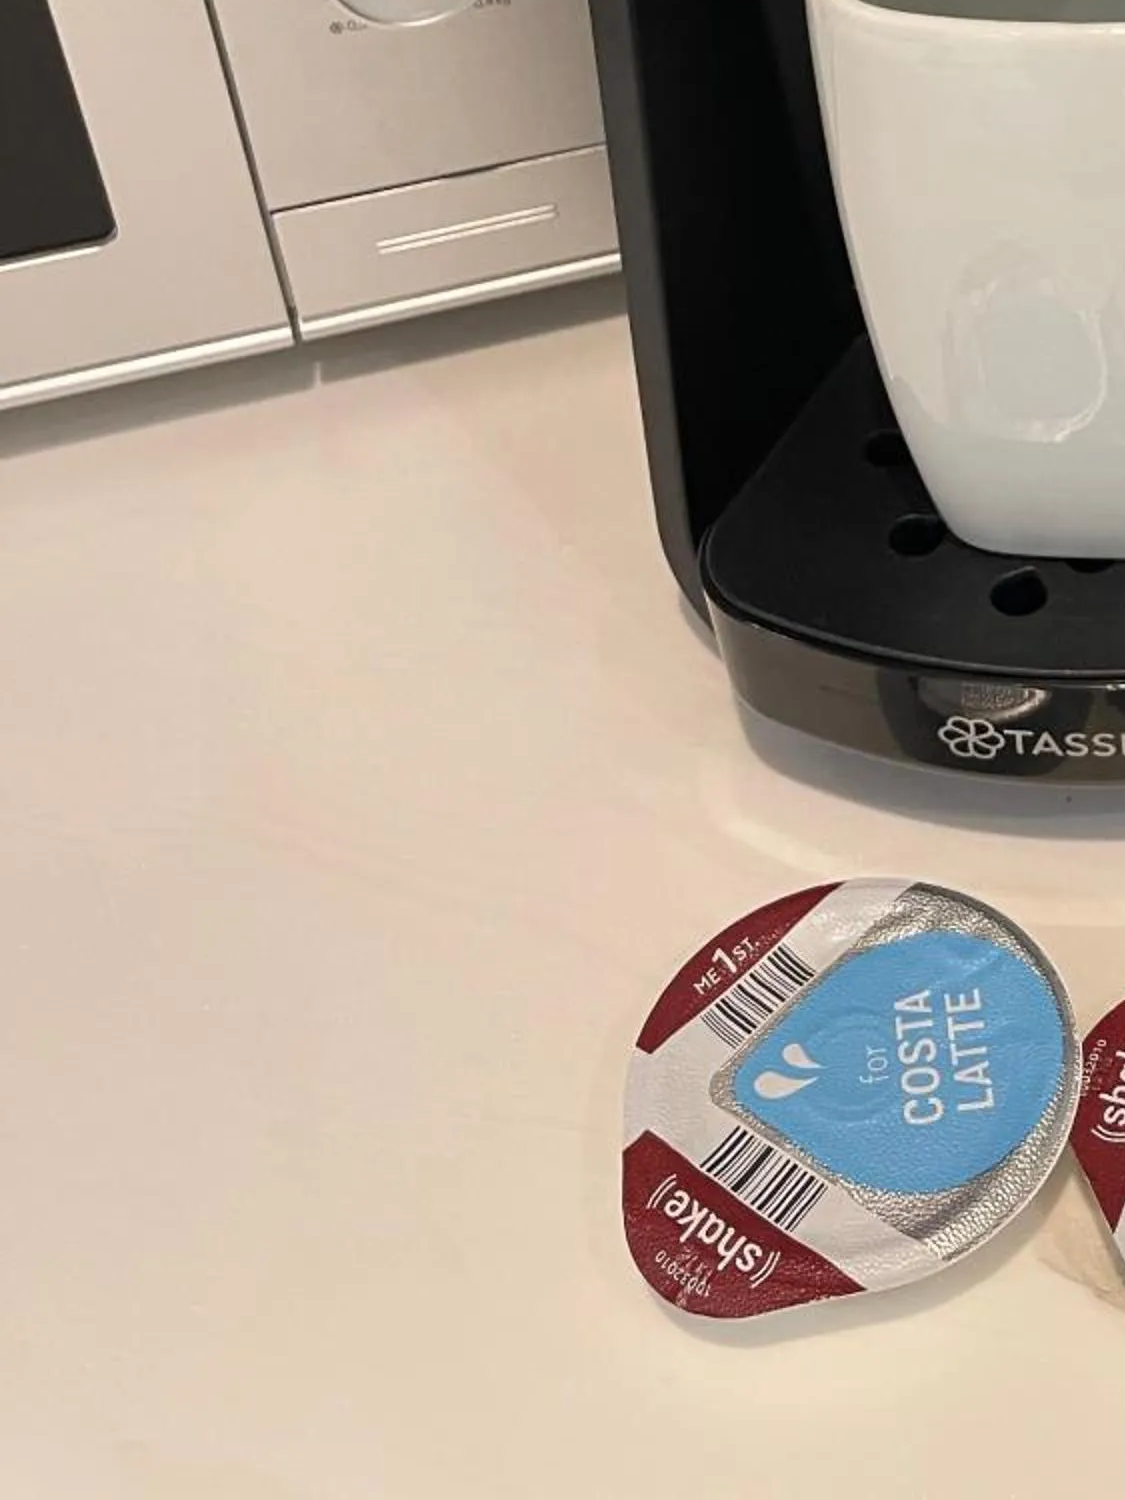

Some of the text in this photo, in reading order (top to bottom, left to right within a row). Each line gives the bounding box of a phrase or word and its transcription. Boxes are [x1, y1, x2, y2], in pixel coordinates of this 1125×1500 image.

[693, 966, 722, 996] ME
[859, 1045, 890, 1085] for
[893, 989, 946, 1128] COSTA
[943, 987, 996, 1114] LATTE
